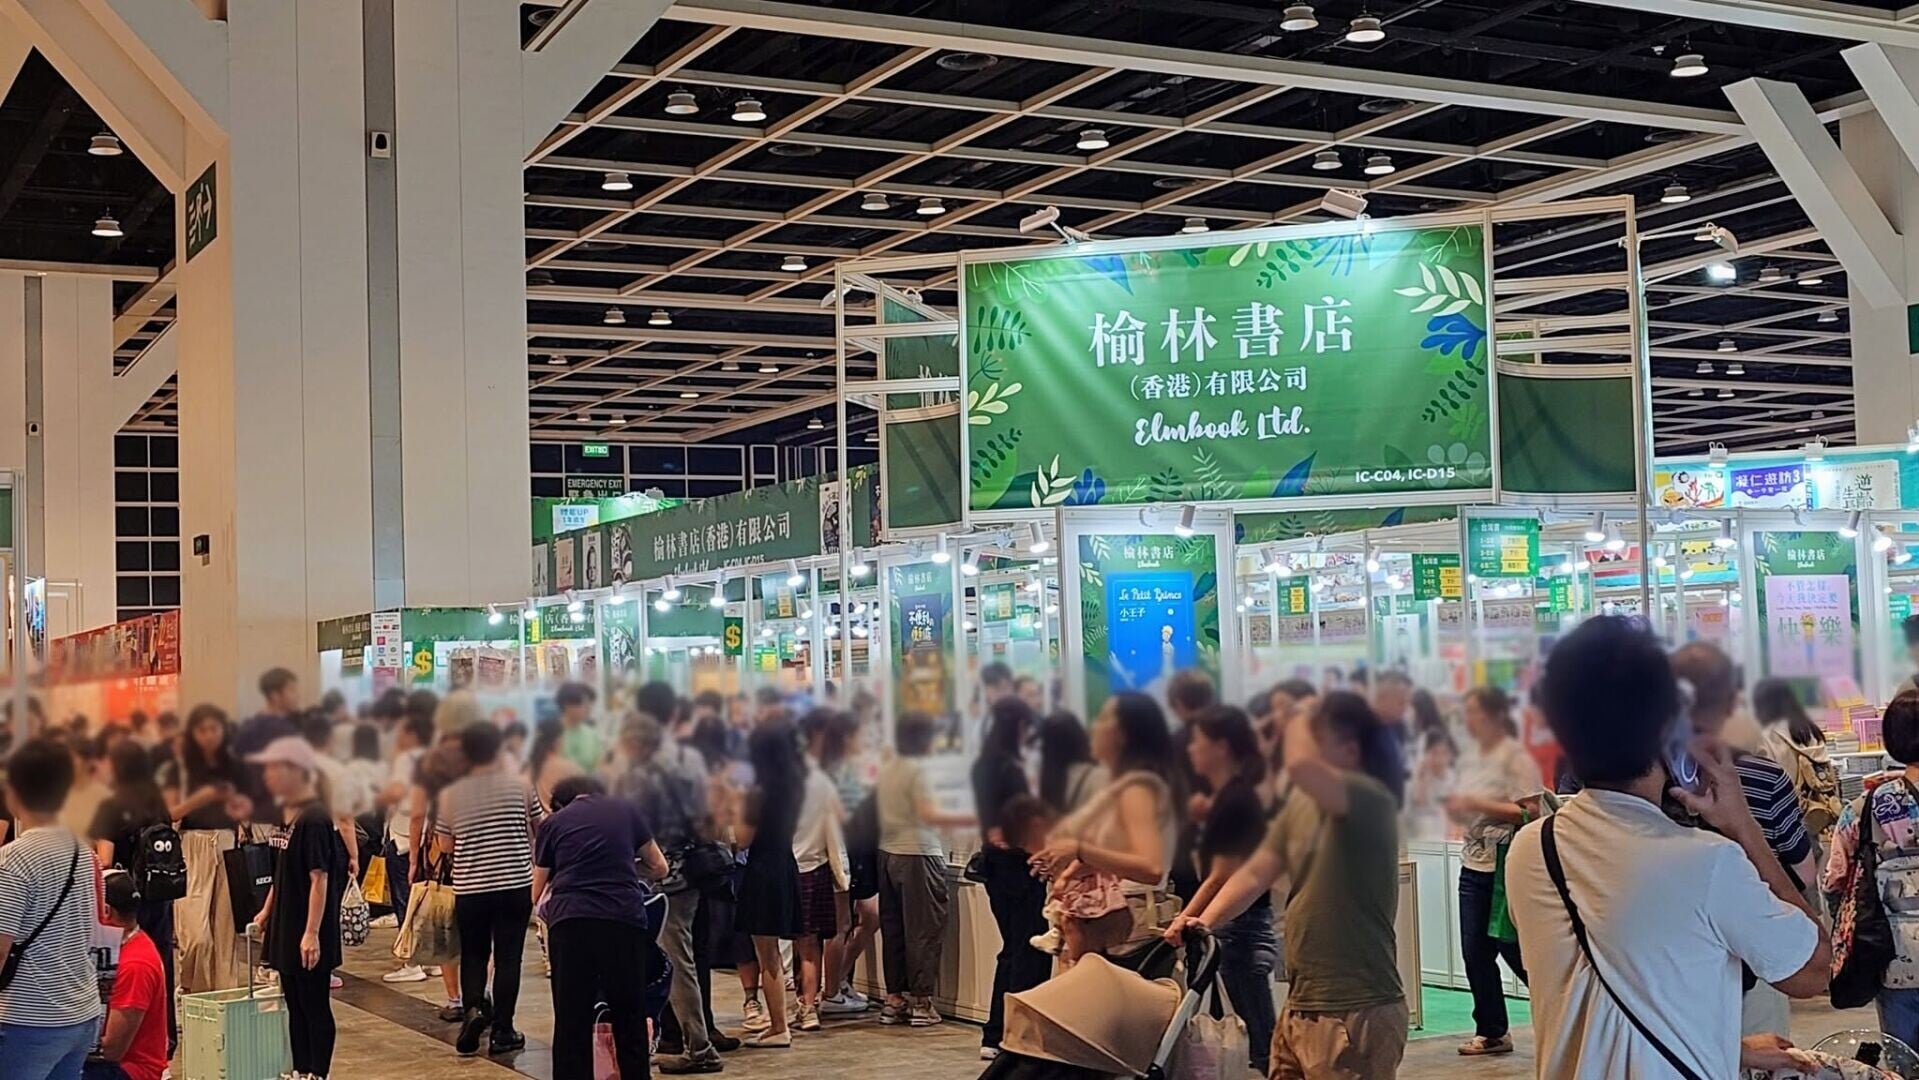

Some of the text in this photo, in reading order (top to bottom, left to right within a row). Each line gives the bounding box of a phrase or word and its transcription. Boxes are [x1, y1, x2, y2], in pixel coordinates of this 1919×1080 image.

[1088, 295, 1354, 367] 榆林書店
[1130, 366, 1308, 400] (香港)有限公司
[1134, 405, 1311, 446] Elmbook Ltd.
[1355, 467, 1456, 483] IC-C04, IC-D15
[567, 478, 623, 489] EMERGENCY EXIT
[653, 511, 790, 562] 榆林書店(香港)有限公司
[1124, 545, 1174, 559] 榆林書店
[1787, 549, 1826, 560] 榆林書店
[1119, 587, 1182, 602] Le Petit Prince
[1120, 607, 1146, 618] 小王子
